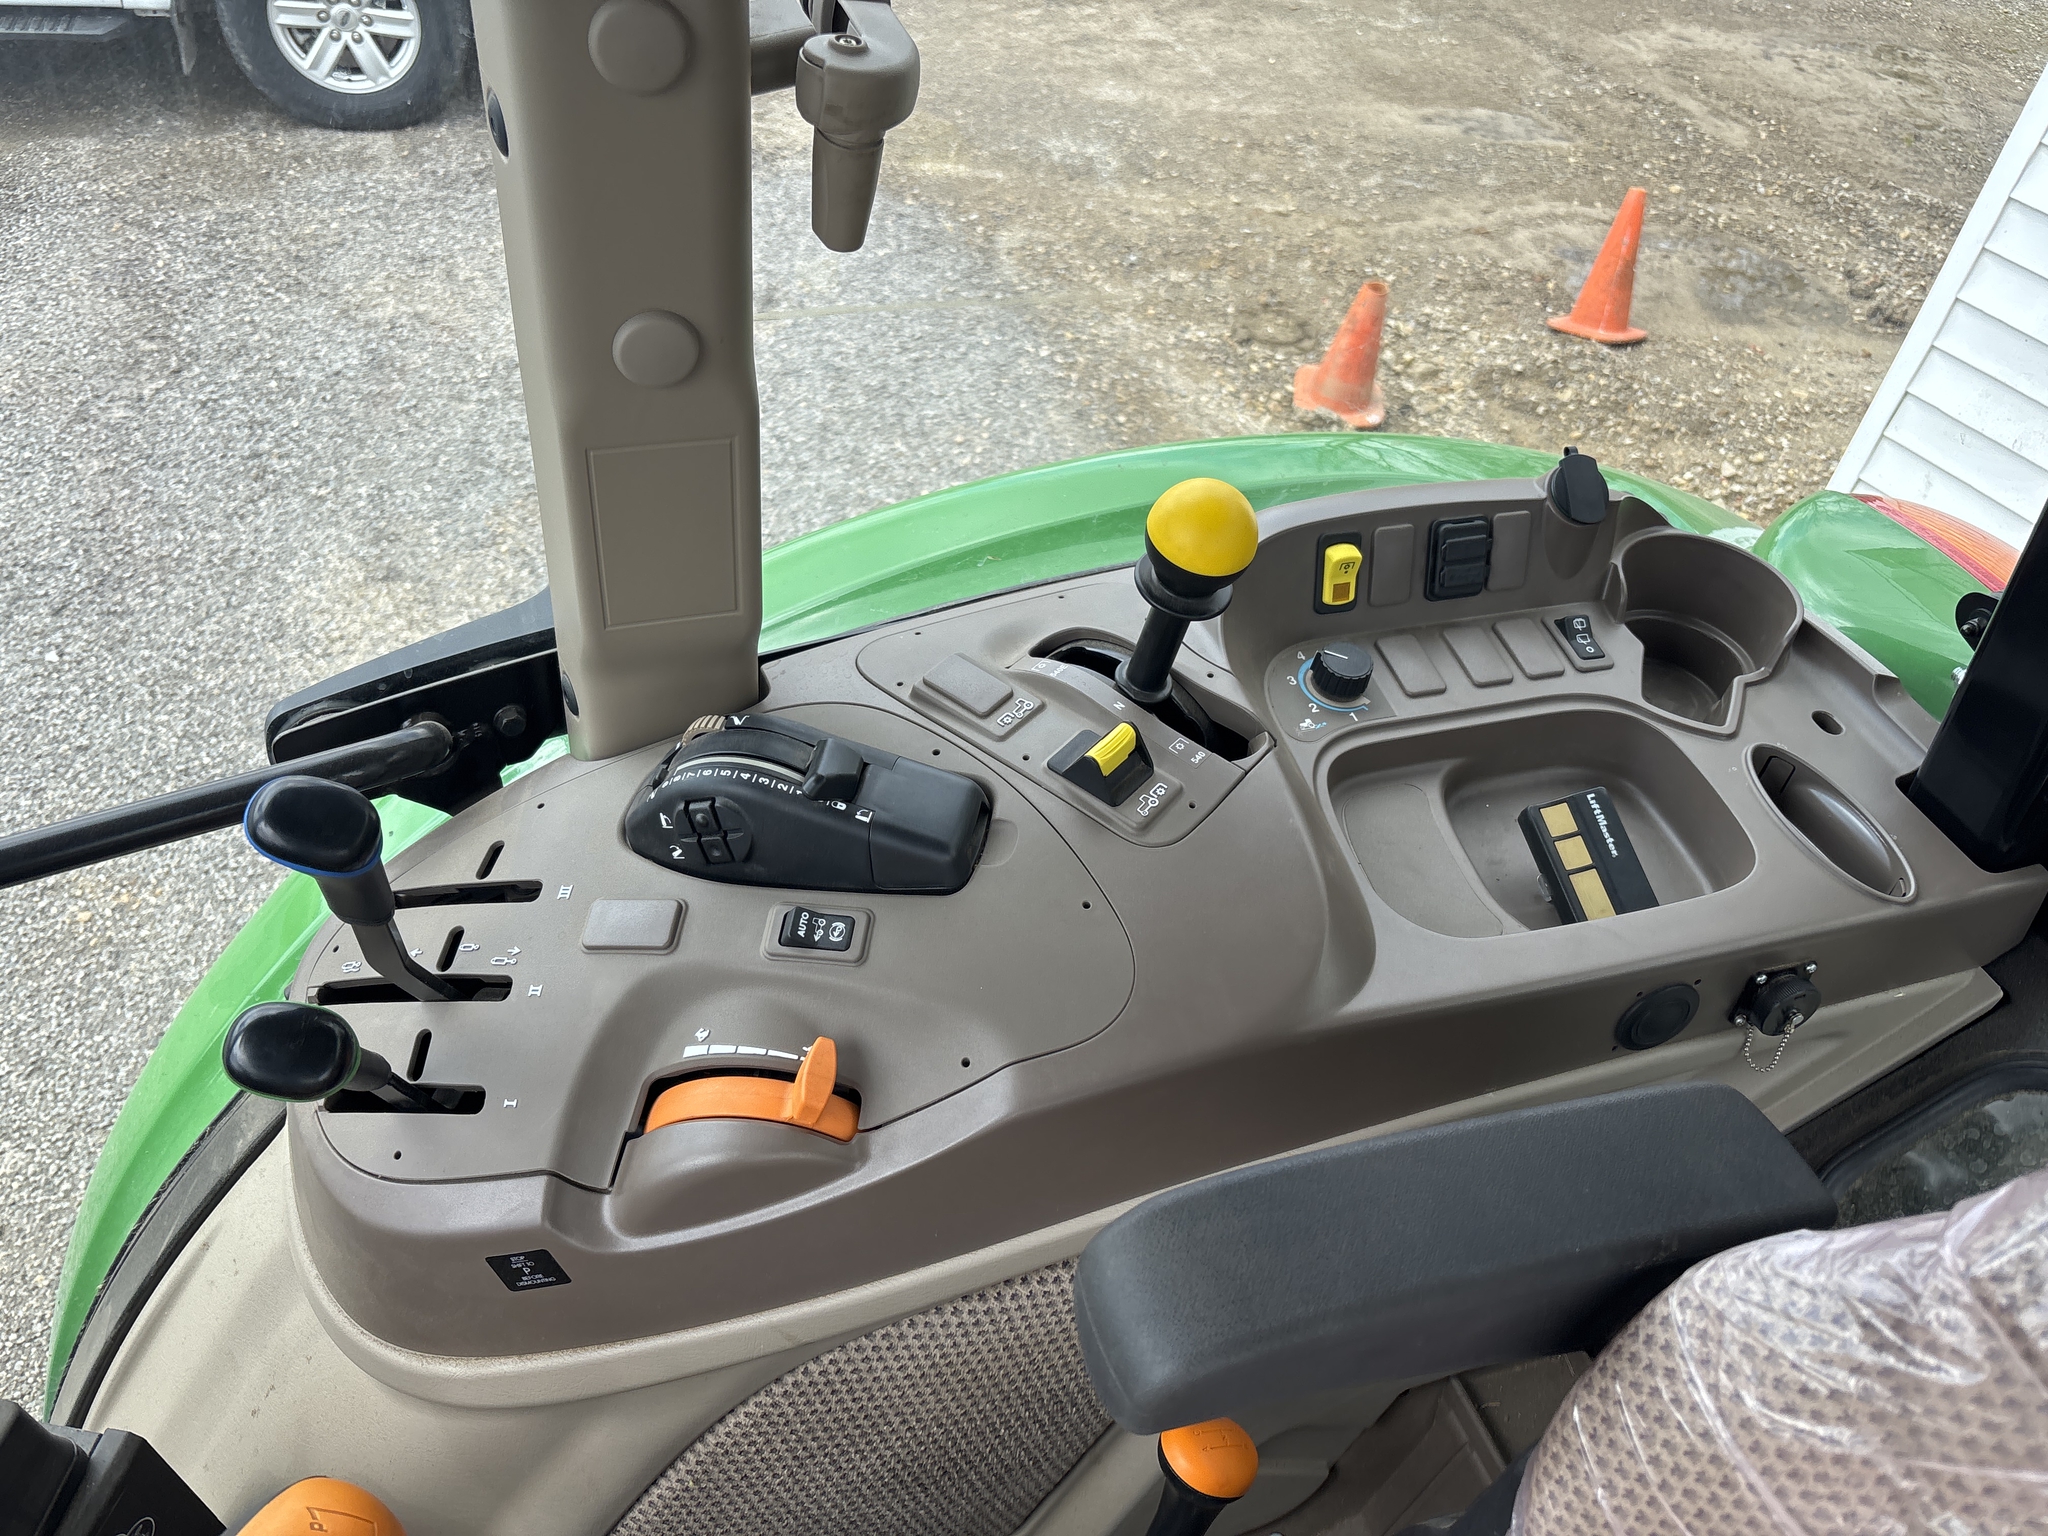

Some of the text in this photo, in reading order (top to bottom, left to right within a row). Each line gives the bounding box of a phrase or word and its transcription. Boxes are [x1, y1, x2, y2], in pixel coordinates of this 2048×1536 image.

[1297, 651, 1306, 660] 4
[1286, 675, 1298, 686] 3
[1113, 700, 1126, 711] N
[1308, 703, 1320, 713] 2
[1349, 712, 1359, 722] 1
[1190, 751, 1206, 764] 540
[686, 771, 696, 779] 7
[720, 769, 732, 777] 5
[740, 771, 752, 780] 4
[758, 776, 770, 785] 3
[777, 783, 789, 792] 2
[797, 911, 809, 938] AUTO
[522, 1267, 531, 1275] P
[515, 1276, 557, 1287] DISMOUNTING
[521, 1273, 544, 1281] BEFORE
